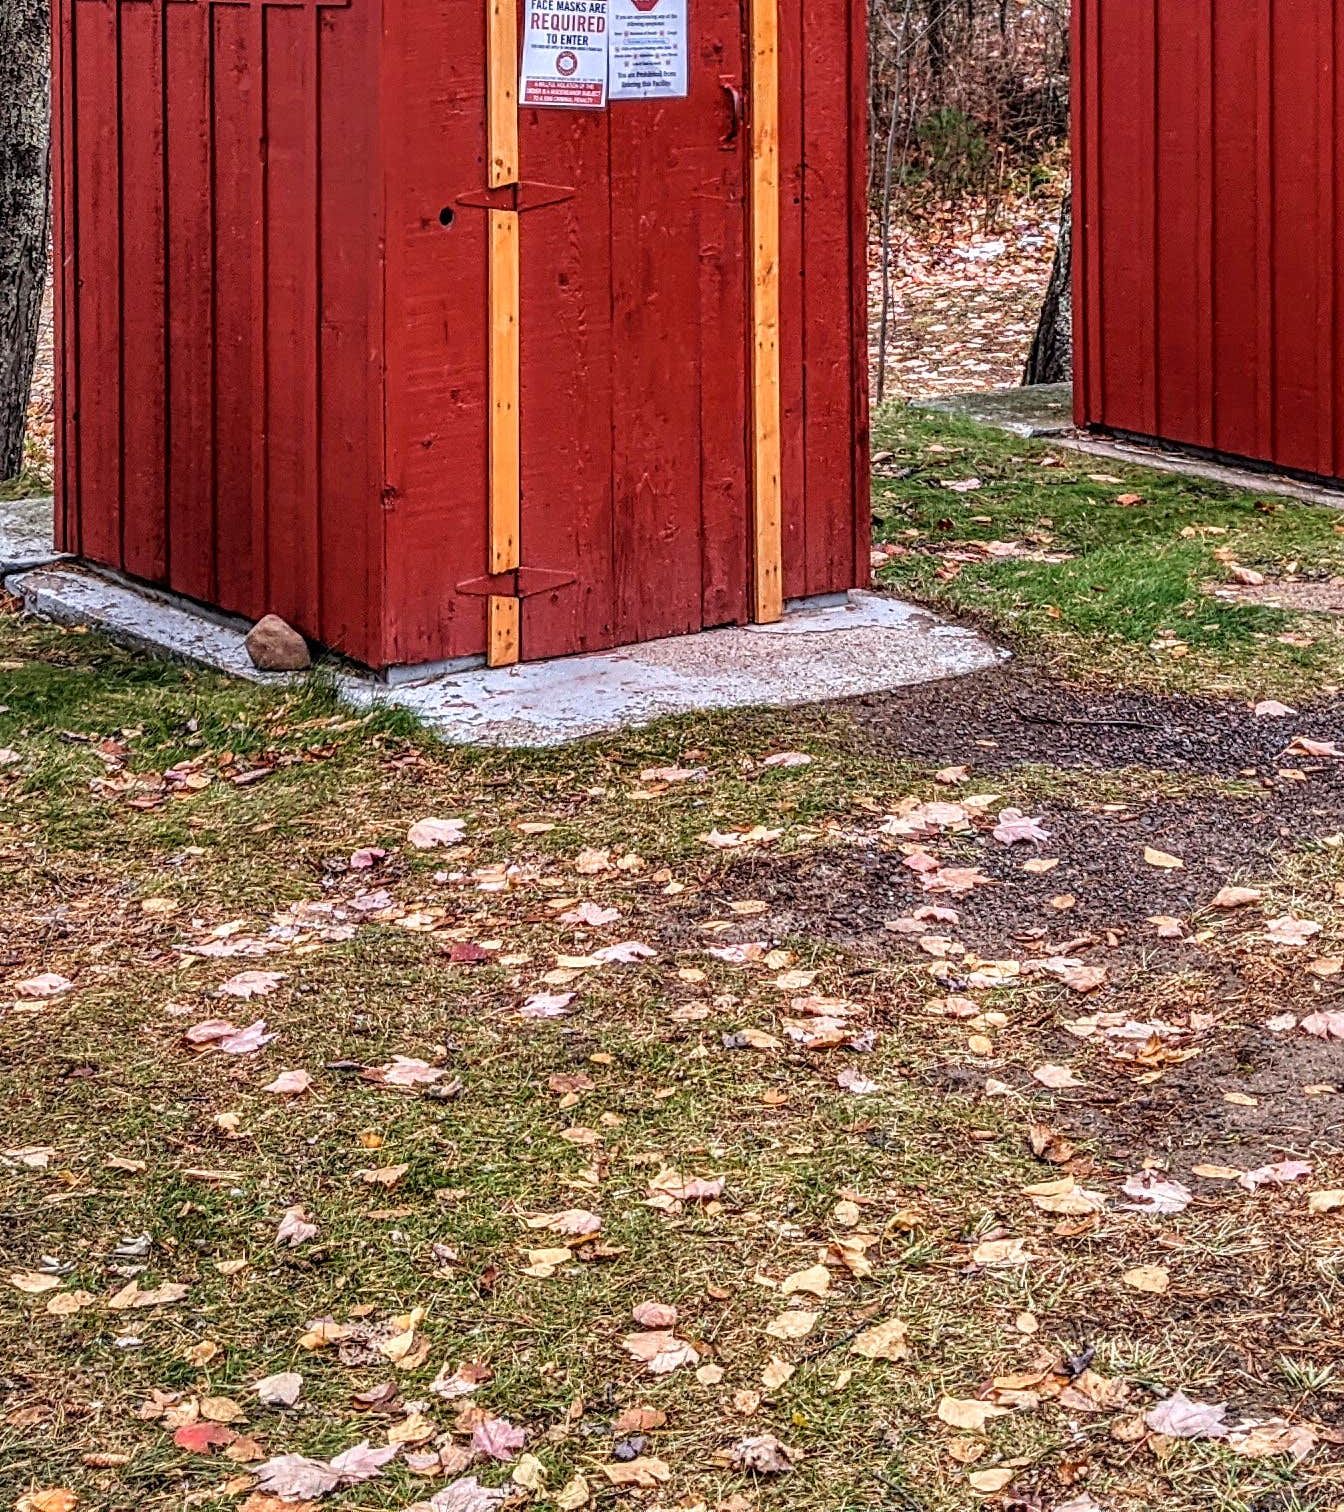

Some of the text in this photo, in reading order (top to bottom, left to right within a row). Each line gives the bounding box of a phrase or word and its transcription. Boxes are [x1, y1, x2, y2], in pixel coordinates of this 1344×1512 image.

[556, 0, 587, 13] MASKS
[588, 2, 607, 14] ARE
[531, 13, 606, 33] REQUIRED
[546, 33, 589, 46] TO ENTER
